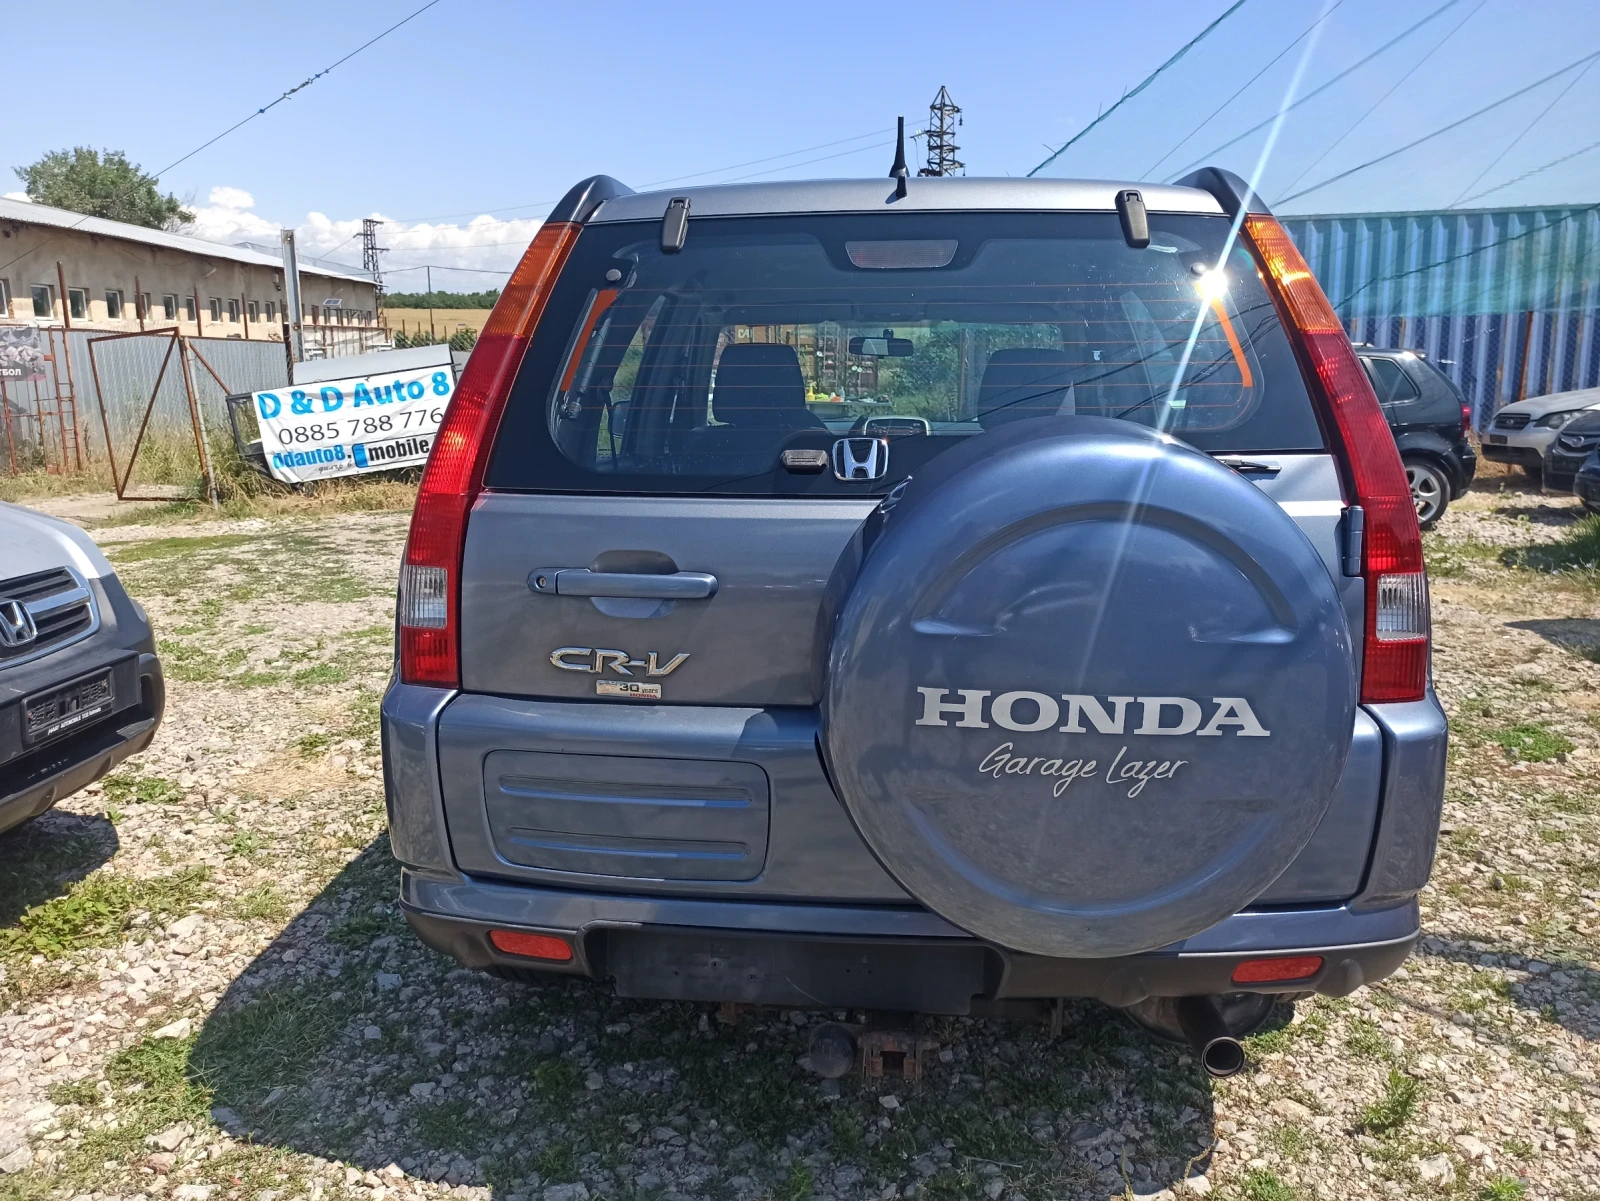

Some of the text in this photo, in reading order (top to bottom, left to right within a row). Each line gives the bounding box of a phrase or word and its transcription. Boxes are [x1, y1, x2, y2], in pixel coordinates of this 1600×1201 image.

[257, 371, 450, 420] D & D Auto 8
[278, 407, 444, 445] 0885 788 776
[549, 645, 691, 677] CR-V
[620, 683, 640, 693] 30
[915, 685, 1271, 738] HONDA
[978, 741, 1189, 799] Garage Lazer
